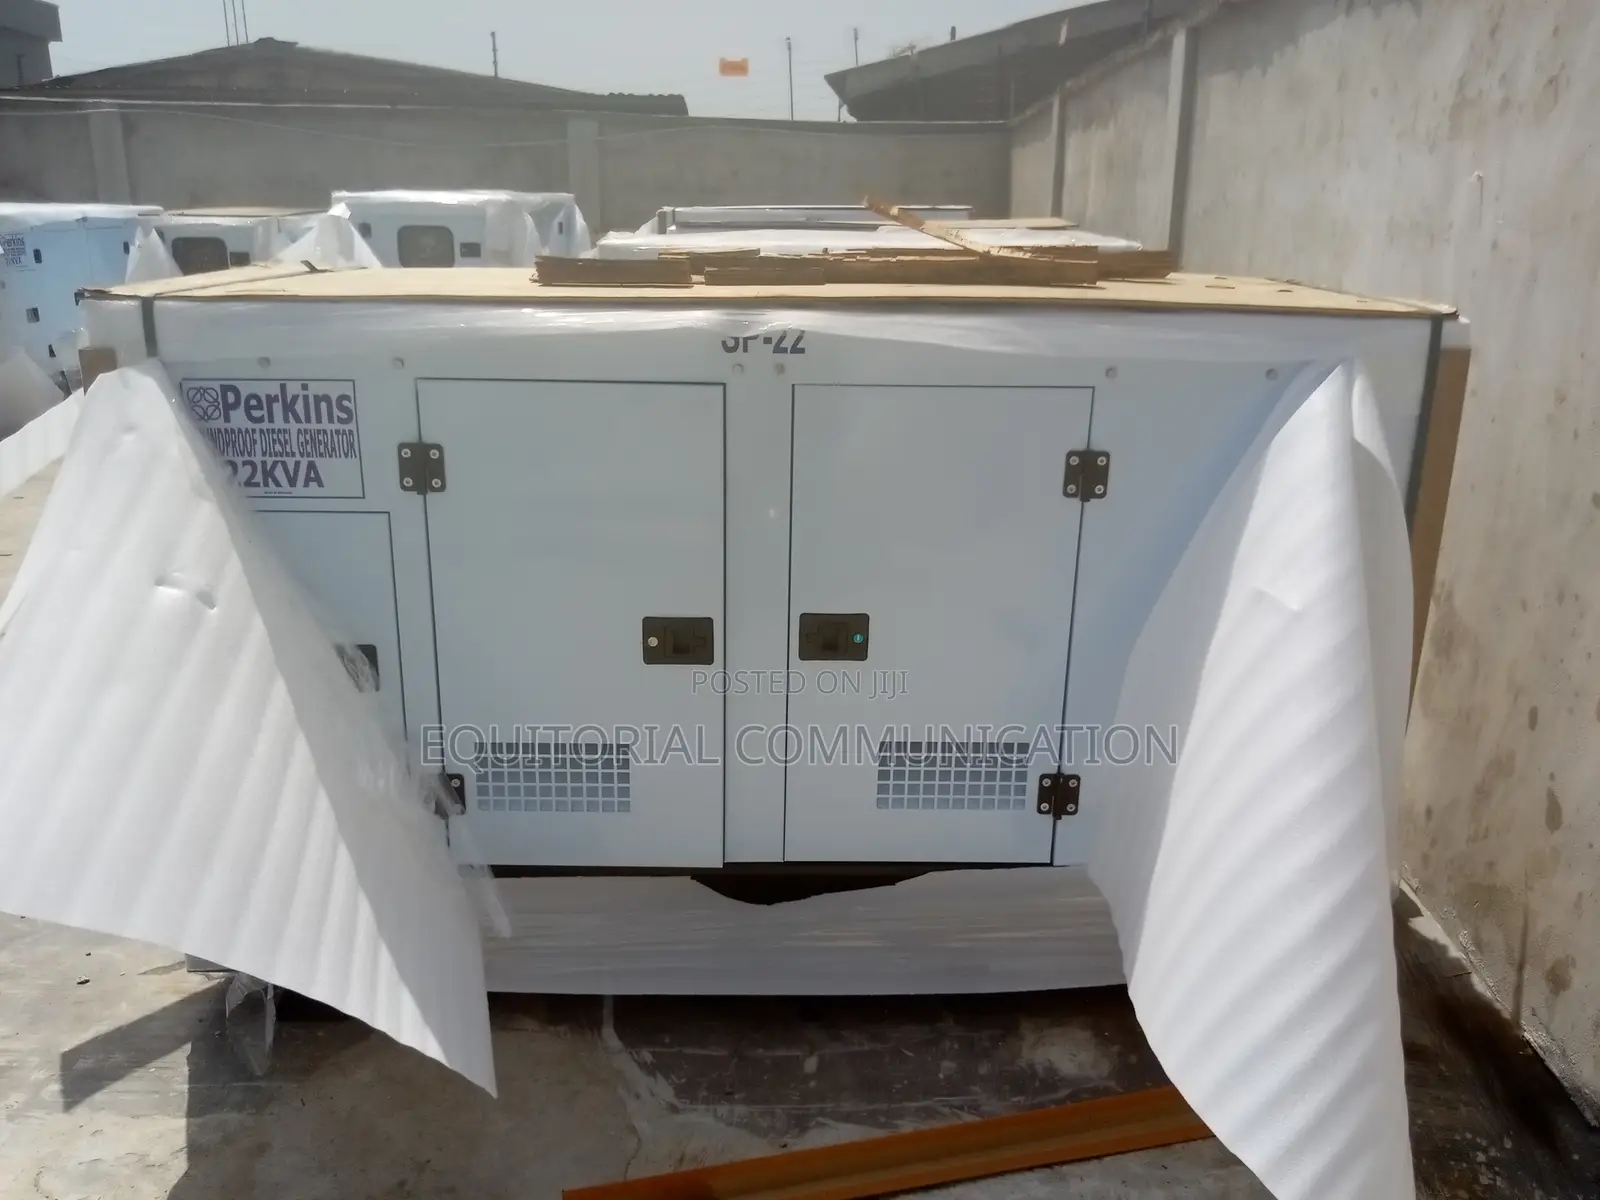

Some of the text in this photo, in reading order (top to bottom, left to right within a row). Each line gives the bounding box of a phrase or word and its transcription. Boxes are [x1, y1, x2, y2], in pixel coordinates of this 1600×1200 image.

[219, 383, 354, 424] Perkins
[259, 428, 296, 458] DIESEL
[297, 429, 357, 459] GENERATOR
